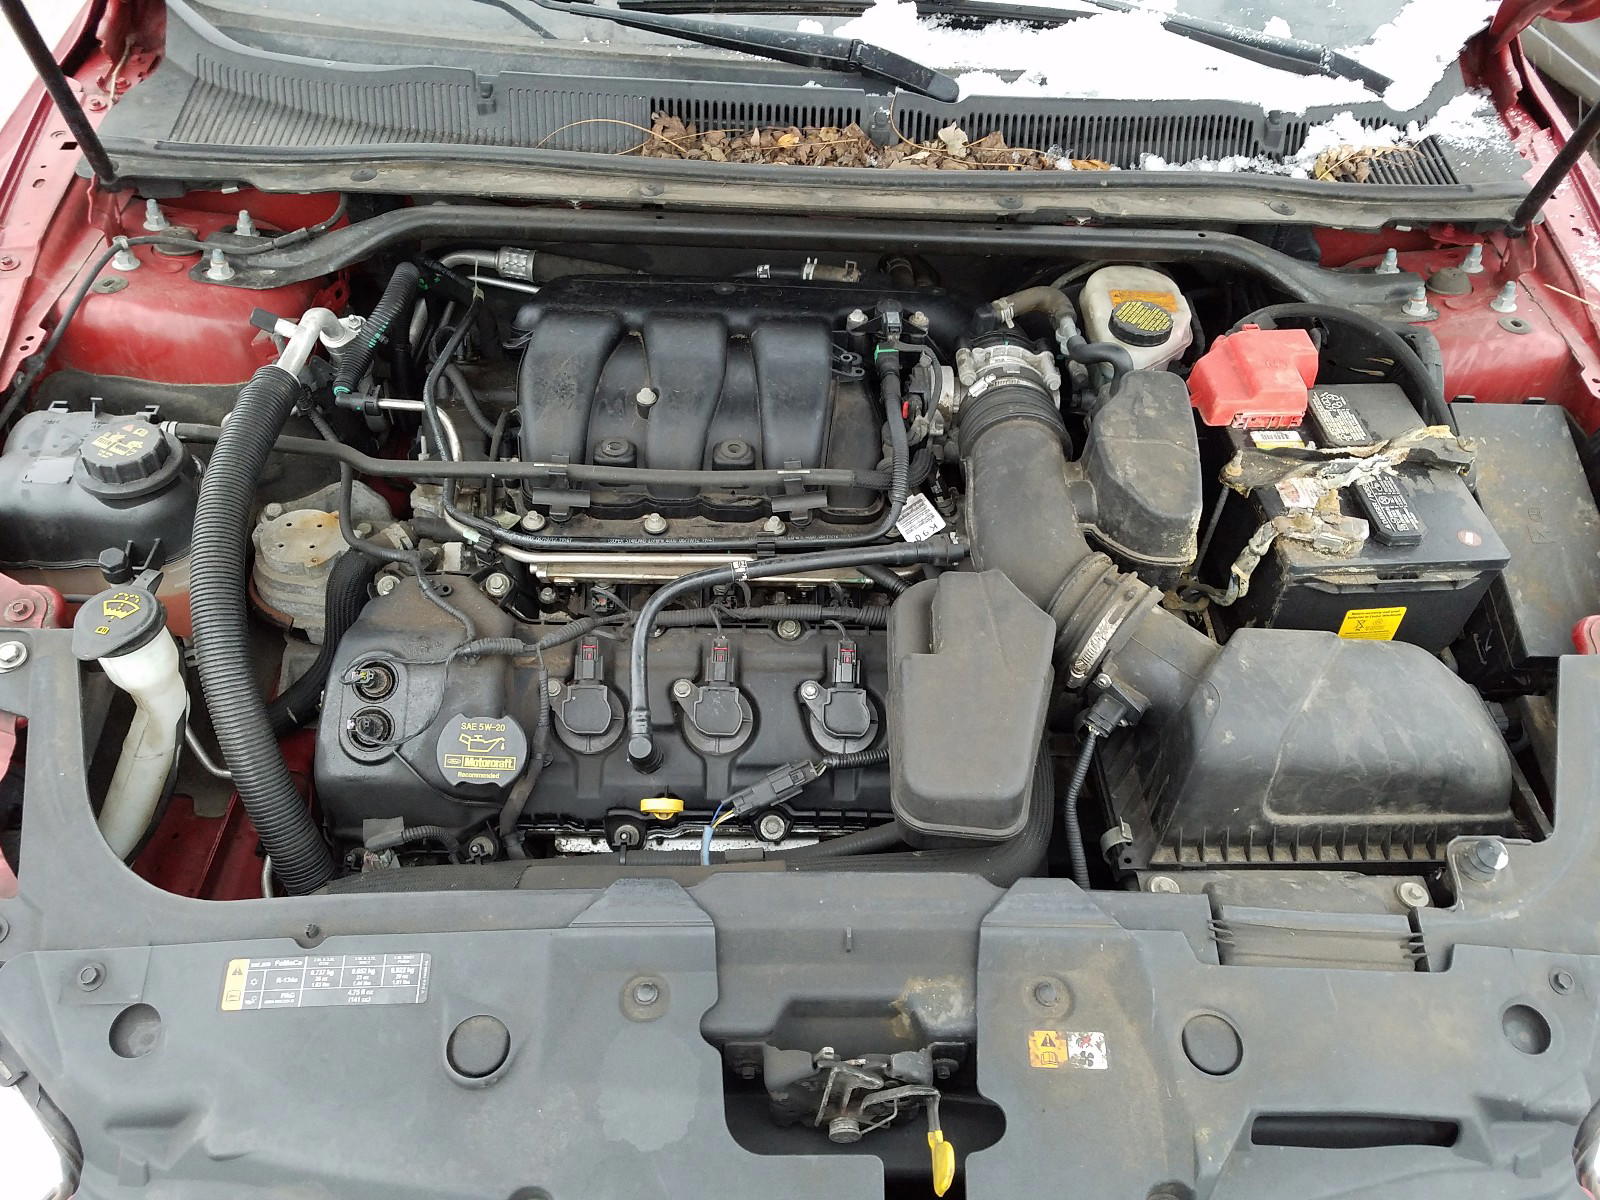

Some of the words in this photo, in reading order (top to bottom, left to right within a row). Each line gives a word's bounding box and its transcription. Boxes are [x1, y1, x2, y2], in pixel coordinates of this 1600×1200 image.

[461, 722, 477, 731] SAE
[479, 723, 506, 732] 5W-20
[464, 757, 513, 769] Motorcraft
[457, 771, 500, 779] Recommended
[327, 969, 335, 977] kg
[367, 967, 376, 976] kg
[406, 966, 415, 975] kg
